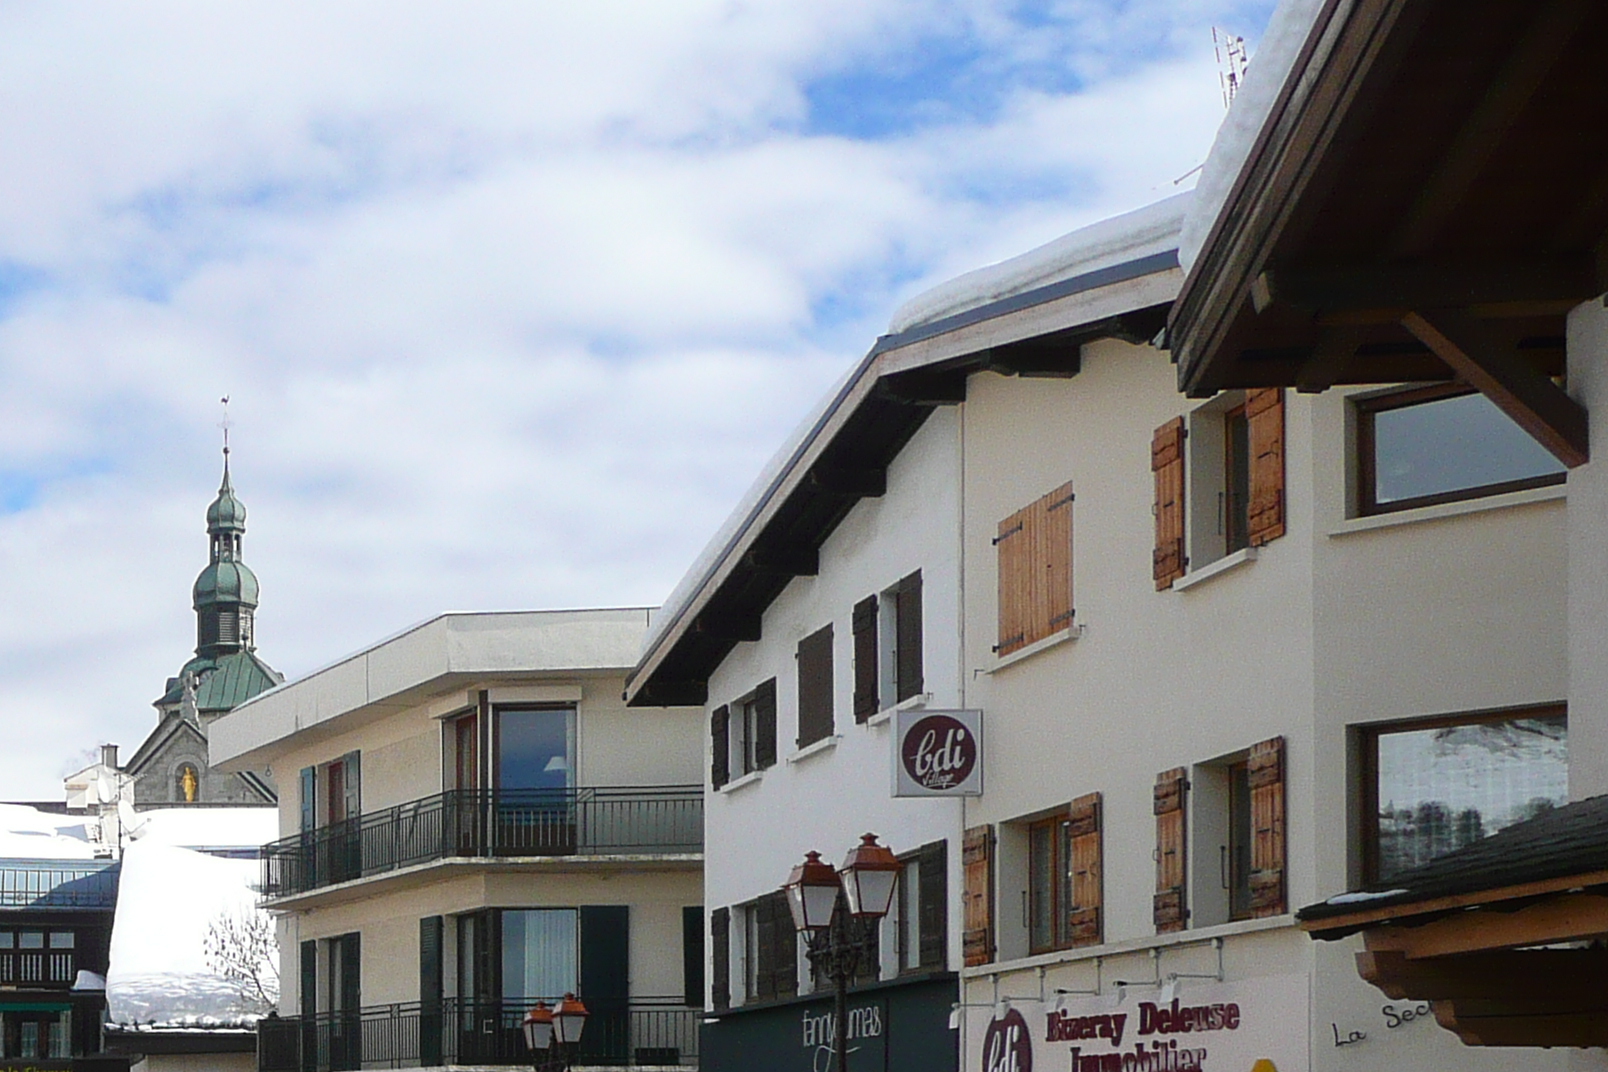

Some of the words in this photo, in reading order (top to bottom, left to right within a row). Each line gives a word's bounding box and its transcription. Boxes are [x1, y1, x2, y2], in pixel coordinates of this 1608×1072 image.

[909, 728, 966, 777] bdi
[1046, 1008, 1128, 1047] Bizeray
[1137, 998, 1241, 1036] Deleuse
[1332, 1022, 1367, 1047] La
